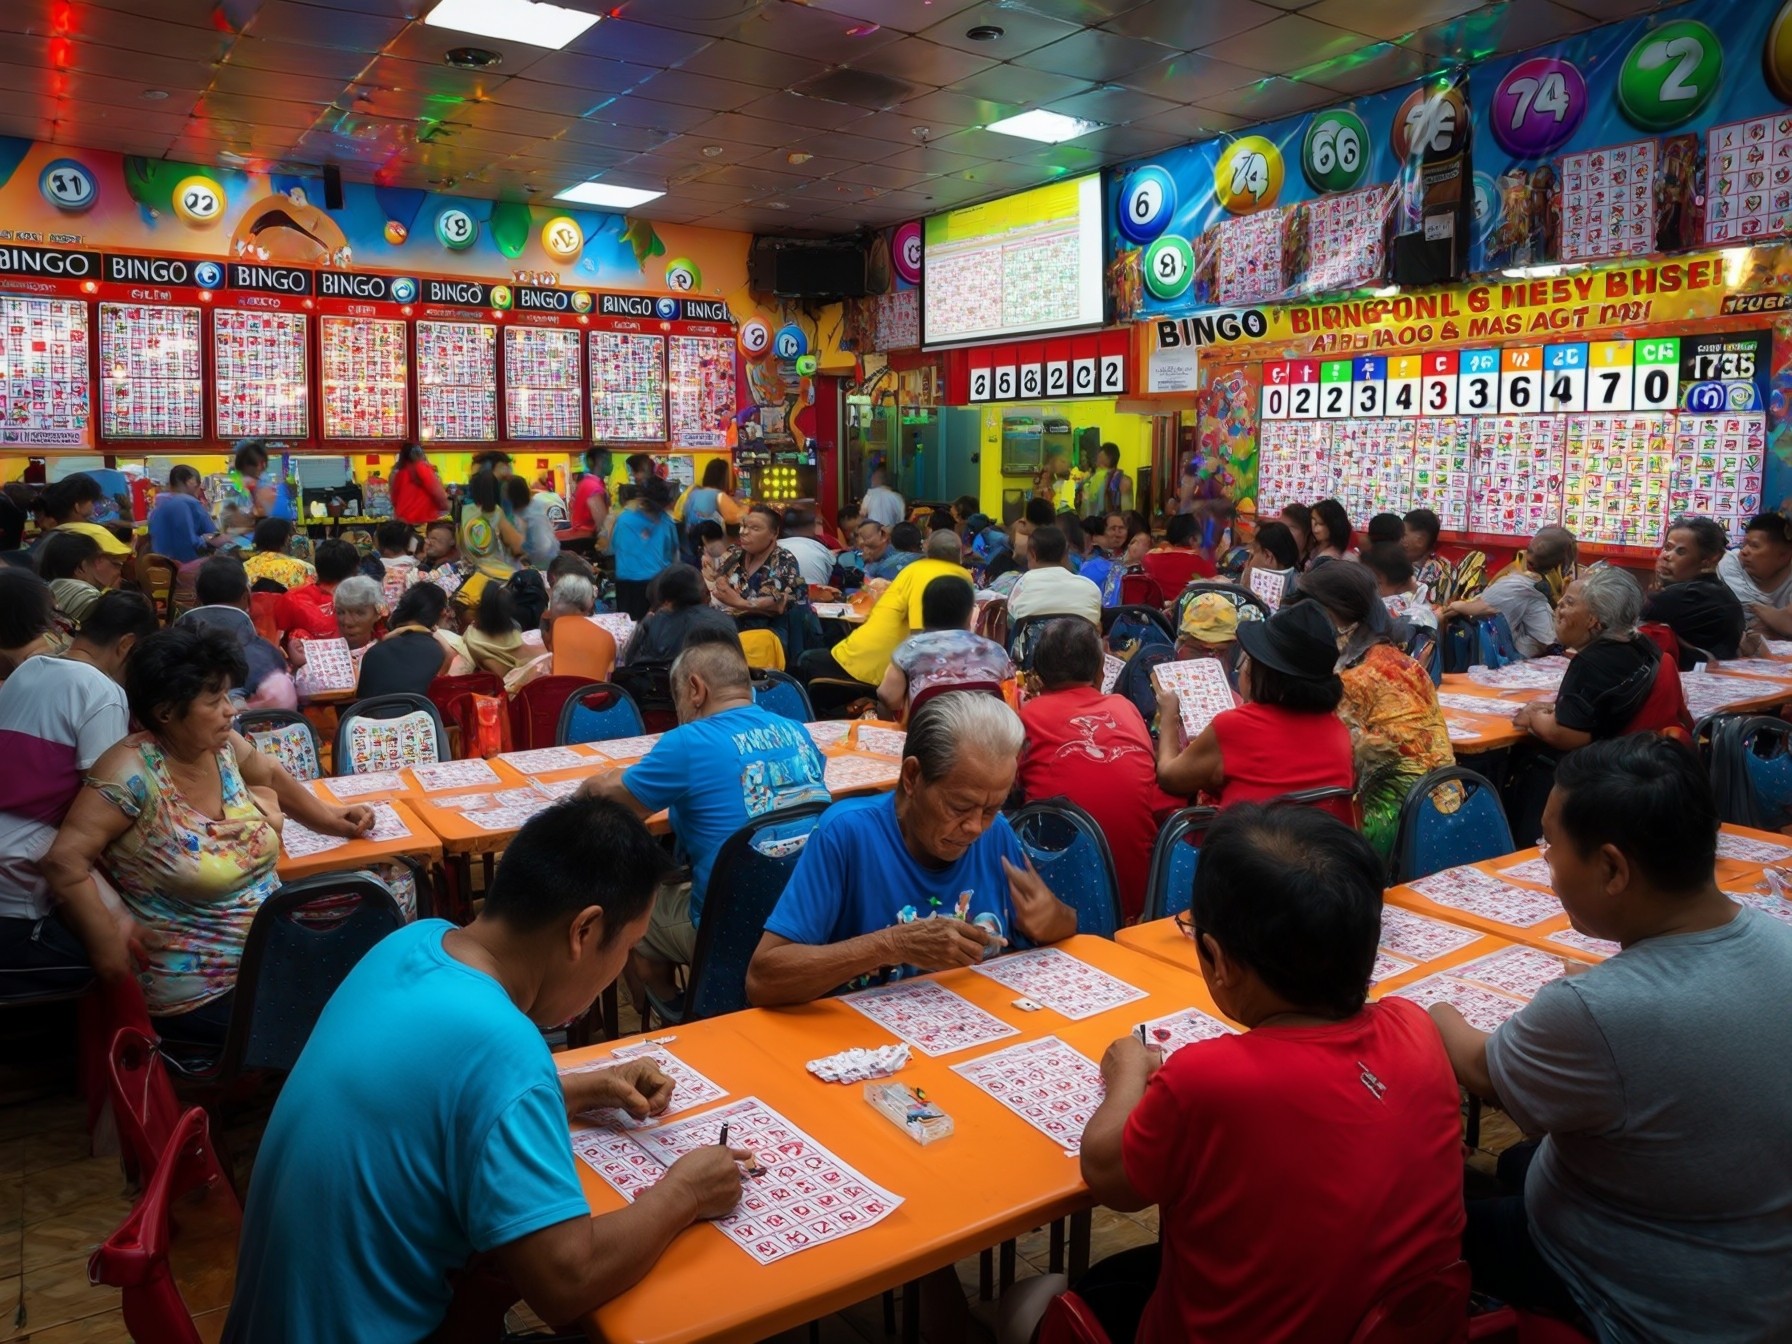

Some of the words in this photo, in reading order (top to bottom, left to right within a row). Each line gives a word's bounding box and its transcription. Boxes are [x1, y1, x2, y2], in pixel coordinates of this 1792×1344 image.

[1659, 37, 1704, 101] 2
[1507, 71, 1569, 131] 74
[1311, 119, 1360, 175] 66
[1135, 191, 1149, 218] 6
[0, 248, 89, 276] BINGO
[112, 257, 188, 283] BINGO
[237, 266, 305, 292] BINGO
[322, 274, 386, 297] BINGO
[431, 282, 482, 304] BINGO
[603, 295, 651, 316] BINGO
[1157, 309, 1268, 348] BINGO
[1051, 367, 1065, 390] 2
[1106, 362, 1119, 387] 2
[1269, 389, 1282, 415] 0
[1295, 387, 1311, 414] 2
[1327, 386, 1344, 413] 2
[1360, 384, 1377, 413] 3
[1396, 383, 1413, 411] 4
[1429, 380, 1448, 411] 3
[1469, 377, 1489, 409] 3
[1509, 375, 1530, 407] 6
[1549, 375, 1572, 404] 4
[1598, 371, 1621, 404] 7
[1644, 368, 1669, 404] 0
